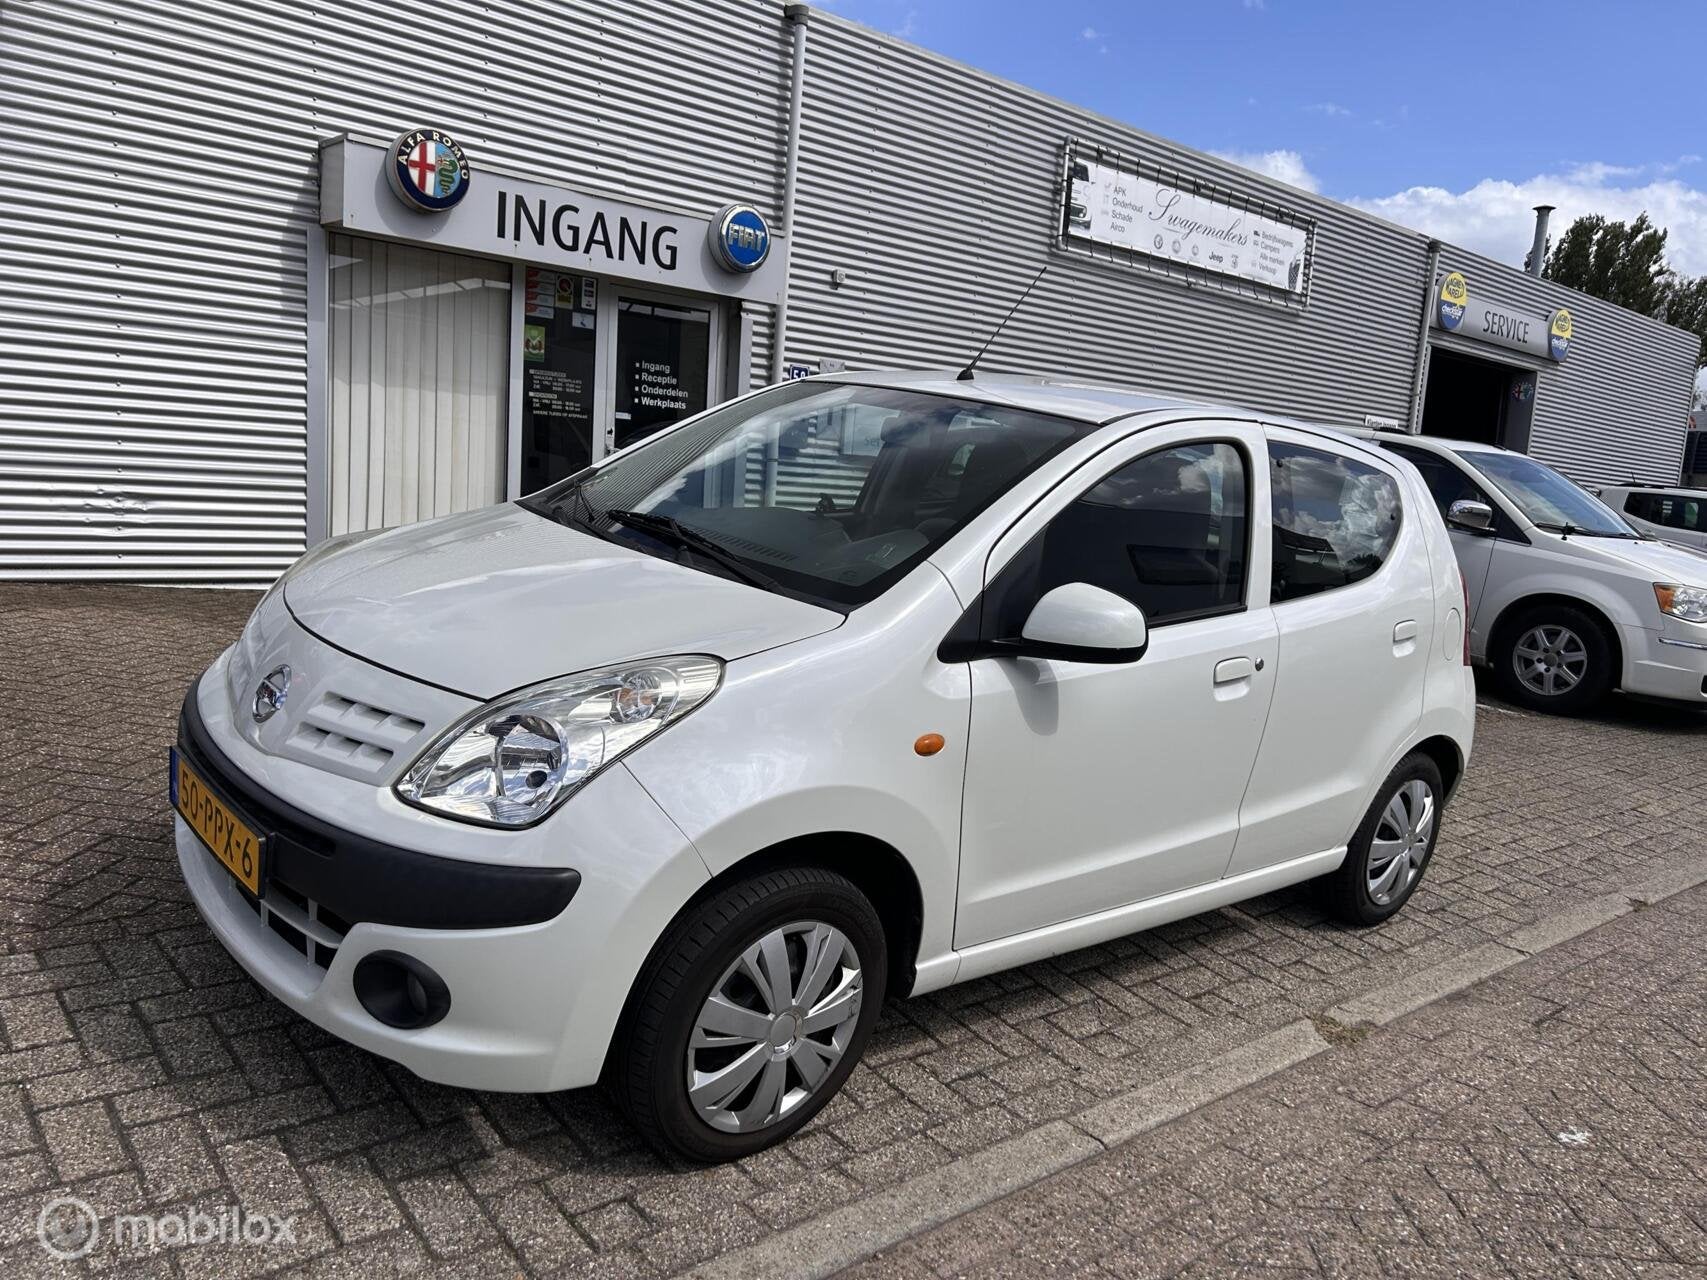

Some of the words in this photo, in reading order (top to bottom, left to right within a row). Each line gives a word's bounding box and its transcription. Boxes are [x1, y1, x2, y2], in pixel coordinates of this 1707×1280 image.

[398, 132, 426, 165] ALFA
[432, 131, 469, 179] ROMEO
[497, 191, 678, 271] INGANG
[1148, 188, 1248, 246] Swagemakers
[728, 222, 765, 252] FIAT
[1209, 251, 1224, 263] Jeep
[1482, 310, 1530, 344] SERVICE
[641, 360, 670, 374] Ingang
[641, 372, 677, 385] Receptie
[641, 384, 689, 398] Onderdelen
[641, 396, 687, 410] Werkplaats
[181, 768, 254, 880] 50-PPX-6
